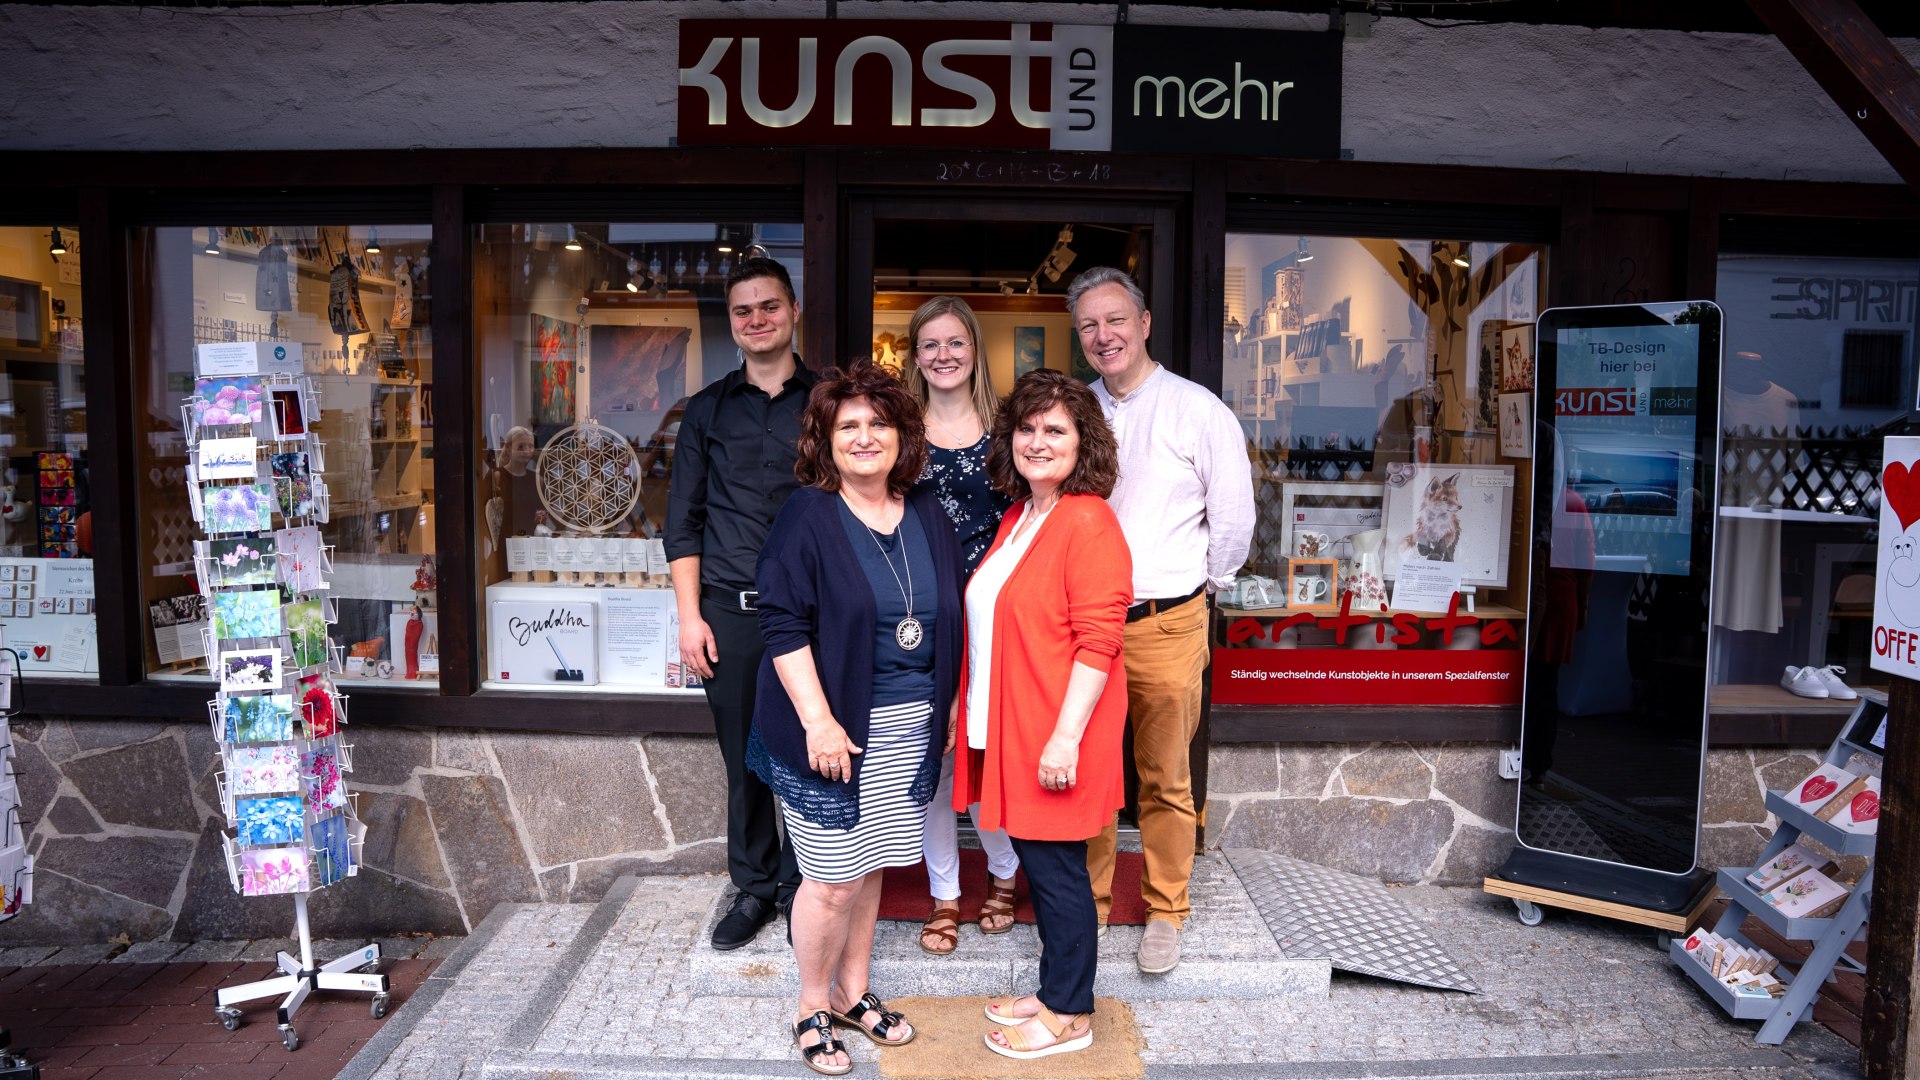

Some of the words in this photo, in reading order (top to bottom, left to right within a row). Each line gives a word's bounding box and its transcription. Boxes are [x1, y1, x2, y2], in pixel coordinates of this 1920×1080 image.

[1069, 46, 1097, 132] UND
[1133, 61, 1294, 121] mehr
[1770, 277, 1919, 323] ESPRIT
[1588, 342, 1666, 356] TB-Design
[1600, 360, 1629, 373] hier
[1633, 359, 1656, 372] bei
[1639, 392, 1648, 413] UND
[1654, 395, 1692, 408] mehr
[508, 608, 590, 647] Buddha
[1227, 589, 1518, 646] artista
[1230, 669, 1268, 682] Ständig
[1268, 669, 1327, 680] wechselnde
[1328, 669, 1390, 682] Kunstobjekte
[1391, 669, 1401, 680] in
[1401, 671, 1443, 680] unserem
[1444, 669, 1511, 682] Spezialfenster
